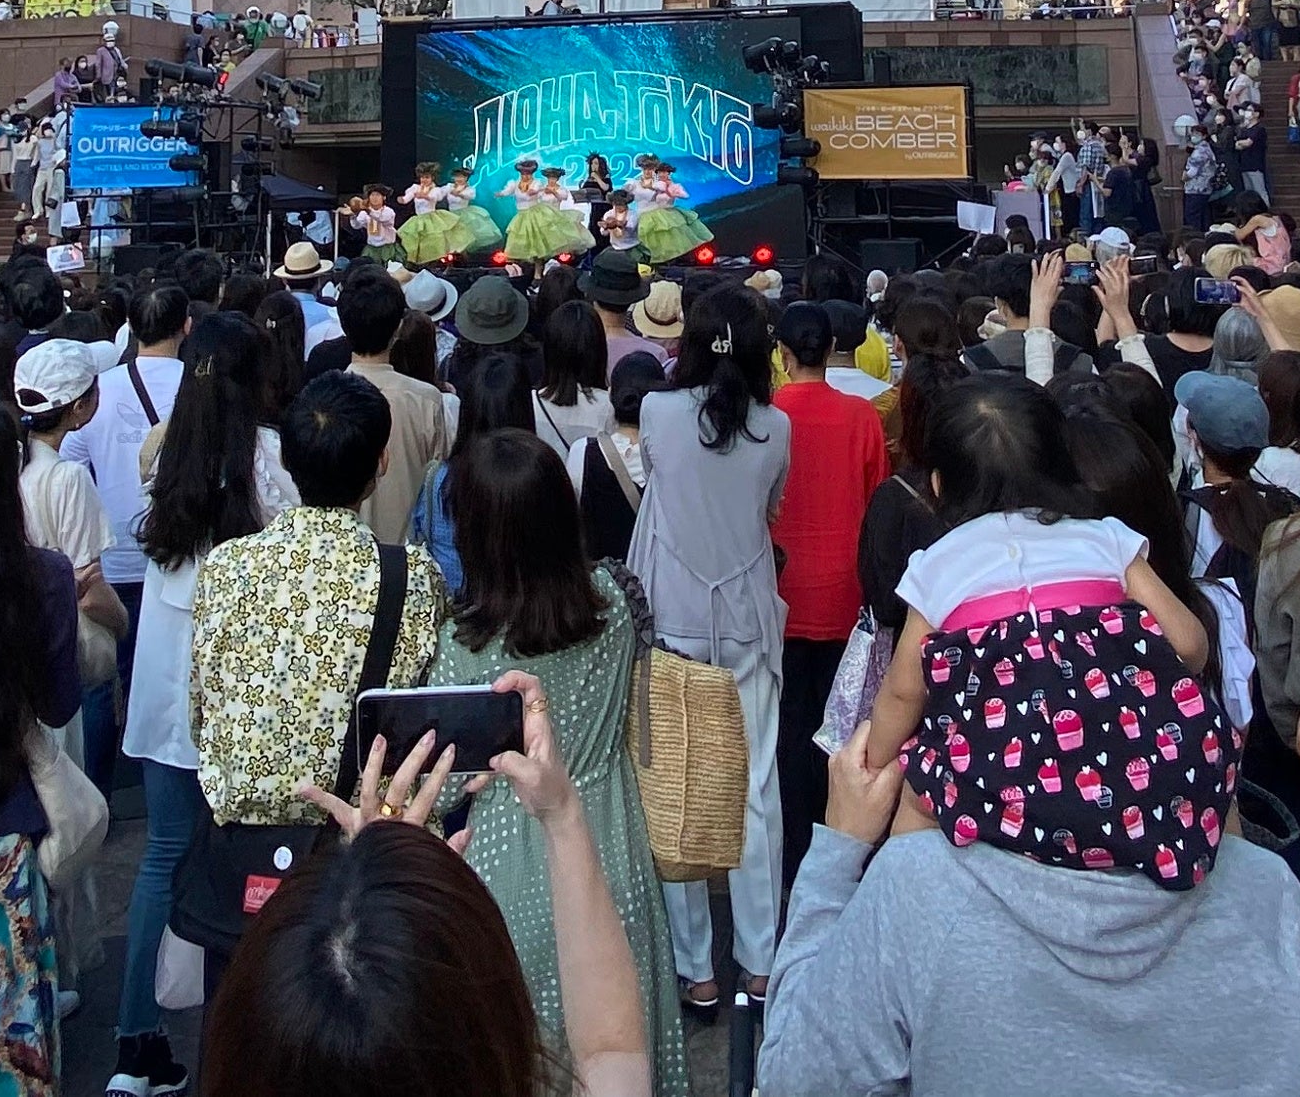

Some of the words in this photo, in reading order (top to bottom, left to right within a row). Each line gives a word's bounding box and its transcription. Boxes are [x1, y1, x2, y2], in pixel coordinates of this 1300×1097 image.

[614, 70, 753, 185] TOKYO
[811, 115, 854, 132] waikiki
[855, 114, 956, 131] BEACH
[77, 136, 188, 153] OUTRIGGER
[829, 132, 957, 150] COMBER
